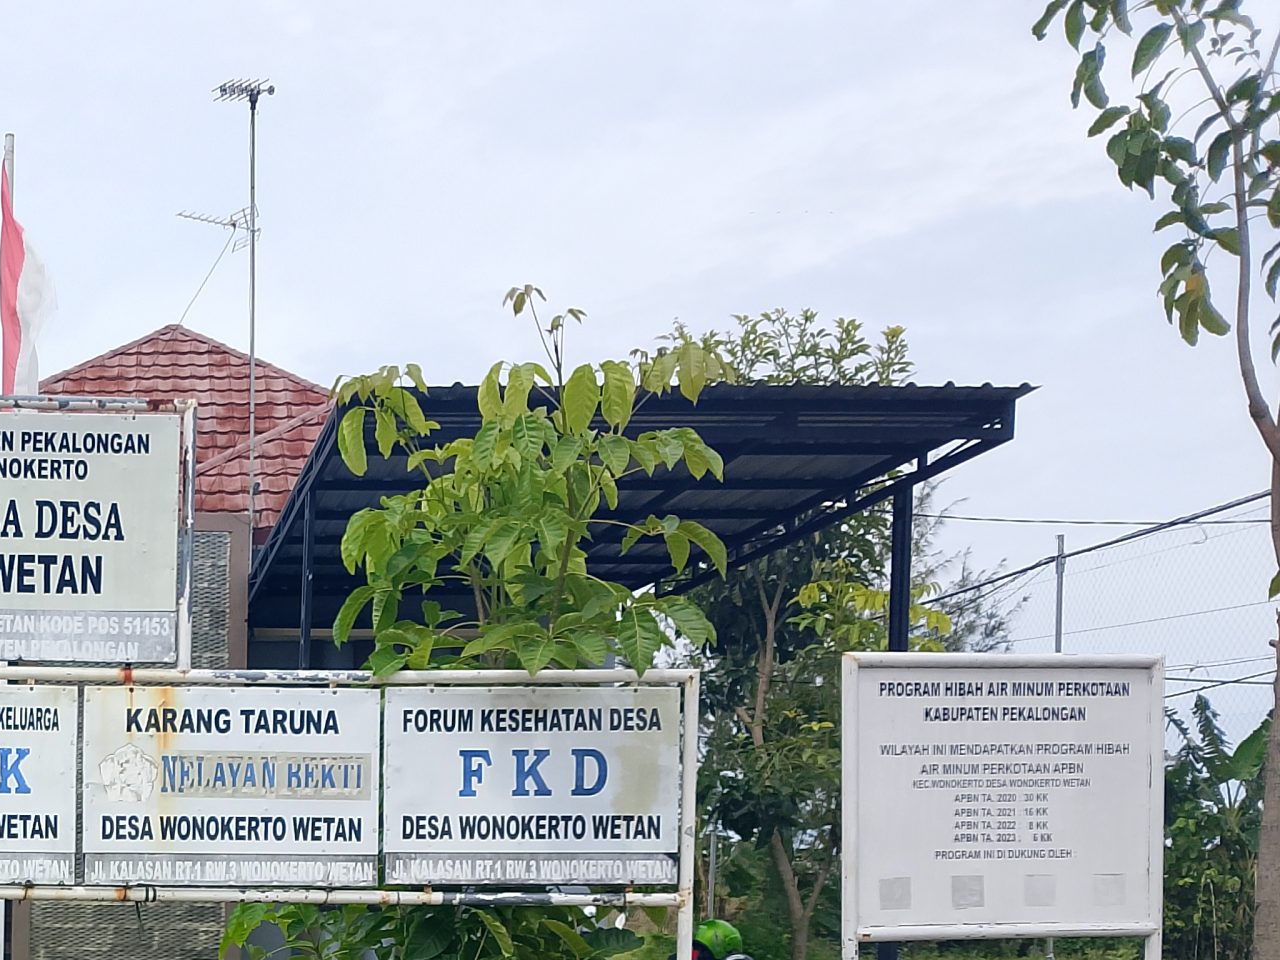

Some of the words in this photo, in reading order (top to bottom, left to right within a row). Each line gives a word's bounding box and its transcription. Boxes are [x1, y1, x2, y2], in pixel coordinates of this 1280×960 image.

[21, 432, 149, 453] PEKALONGAN
[35, 501, 124, 540] DESA
[40, 616, 82, 635] KODE
[88, 617, 119, 635] POS
[880, 683, 940, 696] PROGRAM
[945, 682, 983, 696] HIBAH
[988, 682, 1007, 696] AIR
[1013, 682, 1053, 696] MINUM
[1059, 682, 1129, 696] PERKOTAAN
[127, 708, 230, 733] KARANG
[240, 710, 338, 734] TARUNA
[404, 710, 473, 732] FORUM
[481, 709, 601, 732] KESEHATAN
[610, 708, 661, 730] DESA
[925, 707, 997, 721] KABUPATEN
[1003, 707, 1085, 721] PEKALONGAN
[881, 745, 929, 755] WILAYAH
[933, 744, 946, 755] INI
[950, 744, 1033, 755] MENDAPATKAN
[1037, 744, 1092, 754] PROGRAM
[1097, 744, 1129, 754] HIBAH
[921, 764, 939, 775] AIR
[943, 764, 979, 774] MINUM
[983, 763, 1050, 774] PERKOTAAN
[1053, 763, 1083, 774] APBN
[986, 779, 1007, 788] DESA
[1063, 778, 1090, 787] WETAN
[955, 794, 979, 802] APBN
[997, 794, 1016, 802] 2020
[1024, 793, 1034, 802] 30
[1037, 793, 1048, 801] KK
[955, 809, 978, 817] APBN
[997, 808, 1015, 816] 2021
[1036, 808, 1048, 816] KK
[102, 816, 153, 840] DESA
[160, 816, 286, 840] WONOKERTO
[293, 817, 361, 841] WETAN
[403, 816, 452, 839] DESA
[459, 815, 585, 839] WONOKERTO
[592, 815, 660, 839] WETAN
[955, 821, 978, 829] APBN
[997, 821, 1016, 829] 2022
[1037, 821, 1048, 829] KK
[954, 834, 978, 842] APBN
[997, 833, 1016, 842] 2023
[1041, 833, 1052, 842] KK
[935, 850, 981, 859] PROGRAM
[984, 850, 994, 859] INI
[1008, 850, 1045, 858] DUKUNG
[24, 859, 70, 878] WETAN
[110, 861, 171, 880] KALASAN
[240, 861, 323, 881] WONOKERTO
[327, 861, 373, 881] WETAN
[411, 859, 470, 879] KALASAN
[540, 860, 622, 879] WONOKERTO
[627, 860, 671, 879] WETAN
